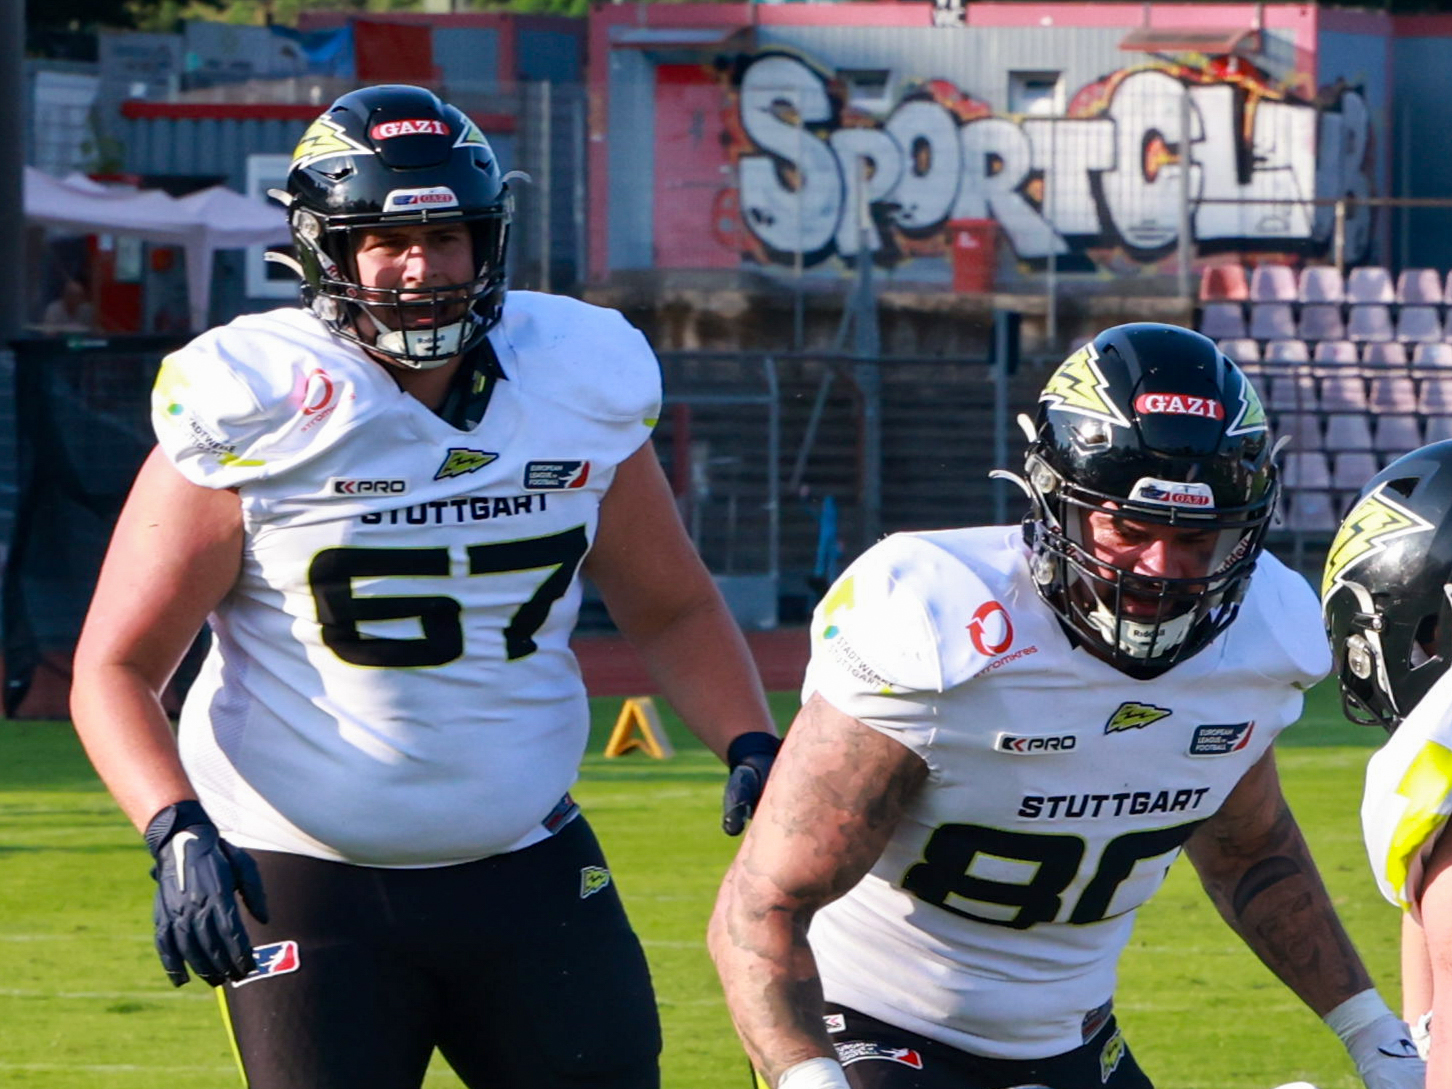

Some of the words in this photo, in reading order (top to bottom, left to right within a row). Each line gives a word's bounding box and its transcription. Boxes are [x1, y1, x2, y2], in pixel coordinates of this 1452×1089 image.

[380, 120, 446, 138] GAZI
[1145, 395, 1217, 419] GAZI
[1175, 493, 1207, 505] GAZI
[307, 524, 589, 668] 67
[1133, 628, 1165, 639] Riddll
[1018, 787, 1210, 819] STUTTGART
[902, 821, 1206, 930] 80
